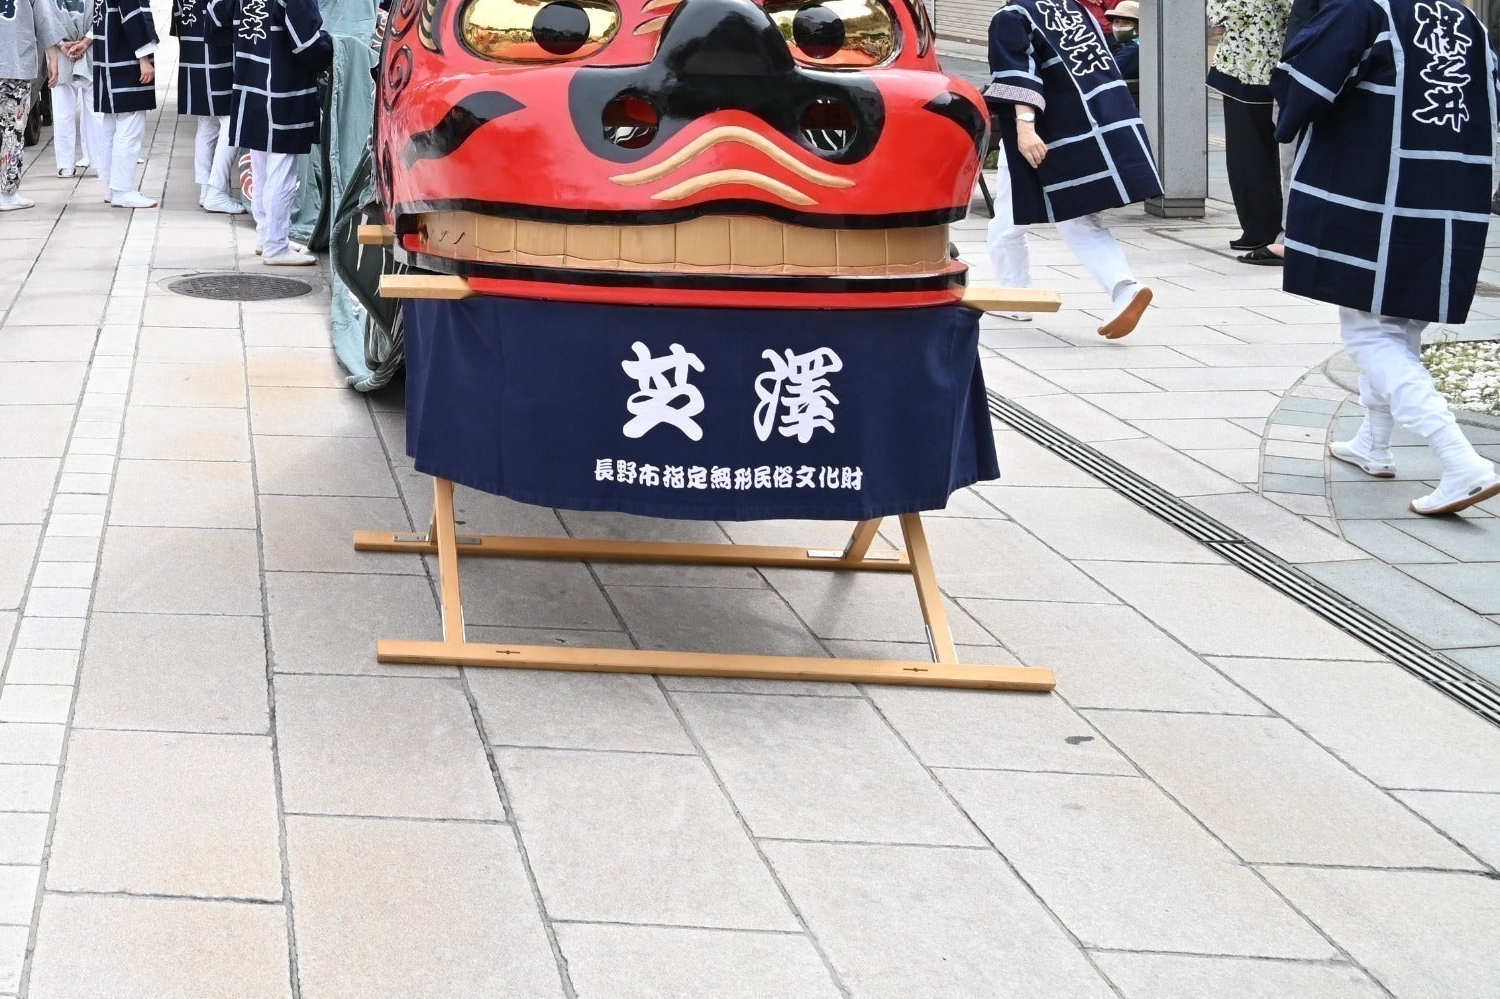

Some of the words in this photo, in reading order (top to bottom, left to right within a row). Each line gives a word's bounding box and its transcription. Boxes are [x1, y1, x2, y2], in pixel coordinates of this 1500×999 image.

[593, 457, 864, 491] 長野市指定無形民俗文化財
